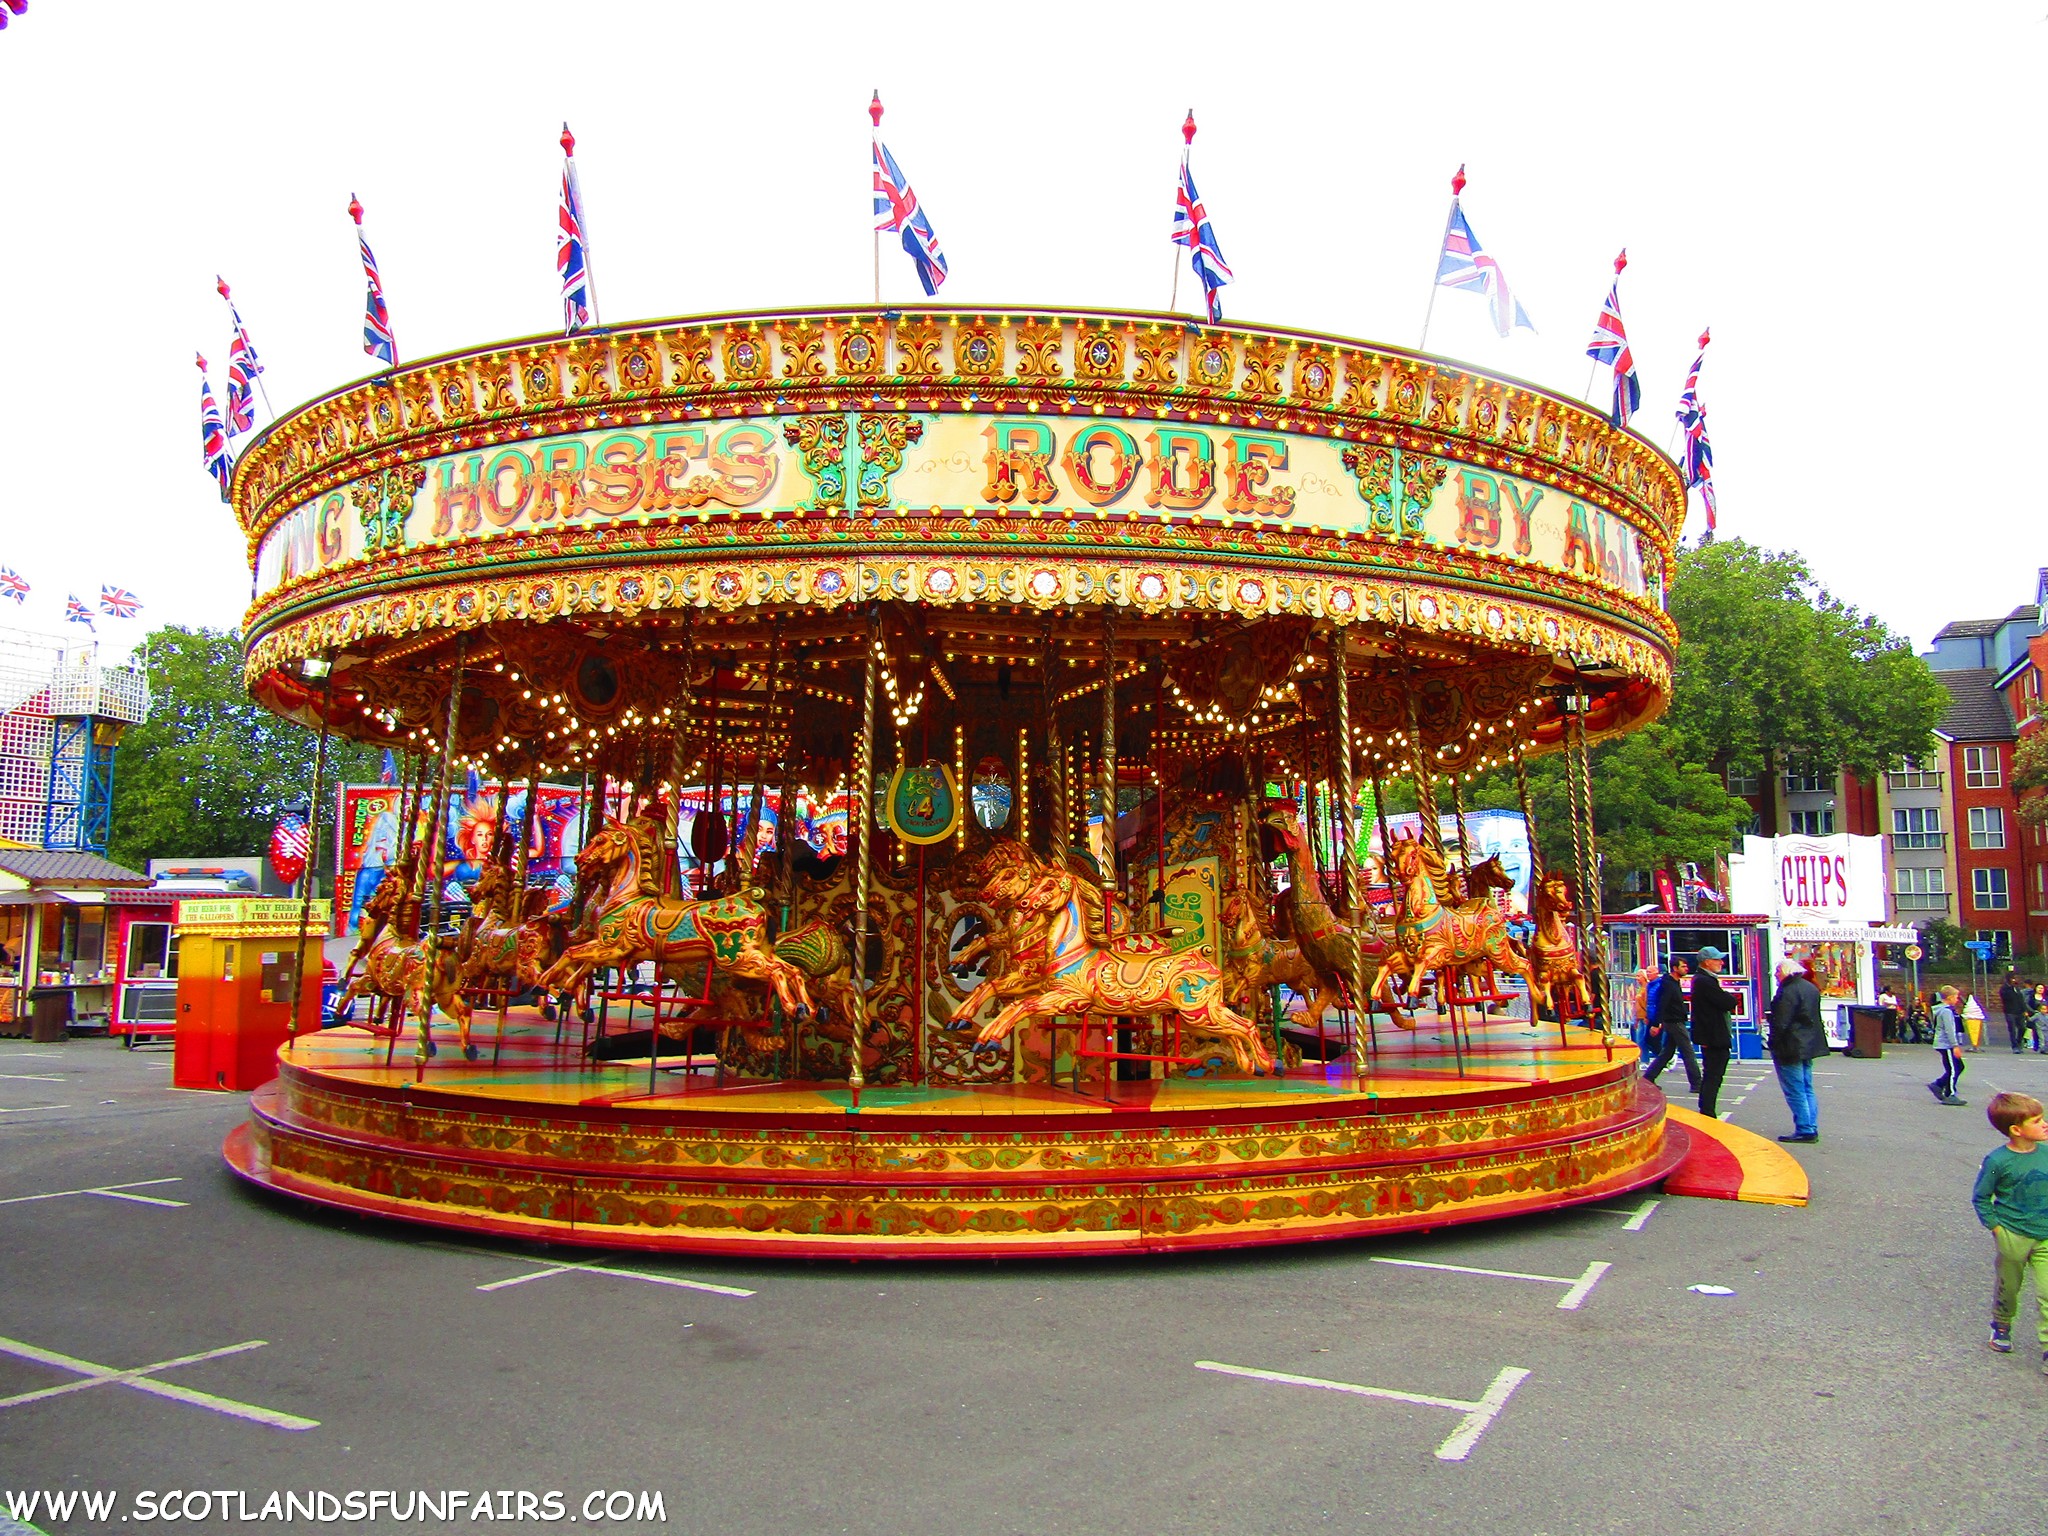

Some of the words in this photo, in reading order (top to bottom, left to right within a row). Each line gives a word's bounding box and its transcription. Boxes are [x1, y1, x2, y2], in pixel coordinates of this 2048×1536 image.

[432, 424, 782, 537] HORSES
[980, 419, 1299, 518] RODE
[1455, 468, 1544, 556] BY
[1781, 854, 1847, 907] CHIPS
[1170, 931, 1201, 949] OYCE
[1787, 929, 1860, 938] CHEESEBURGERS
[1864, 930, 1877, 938] HOT
[1899, 931, 1915, 940] PORK
